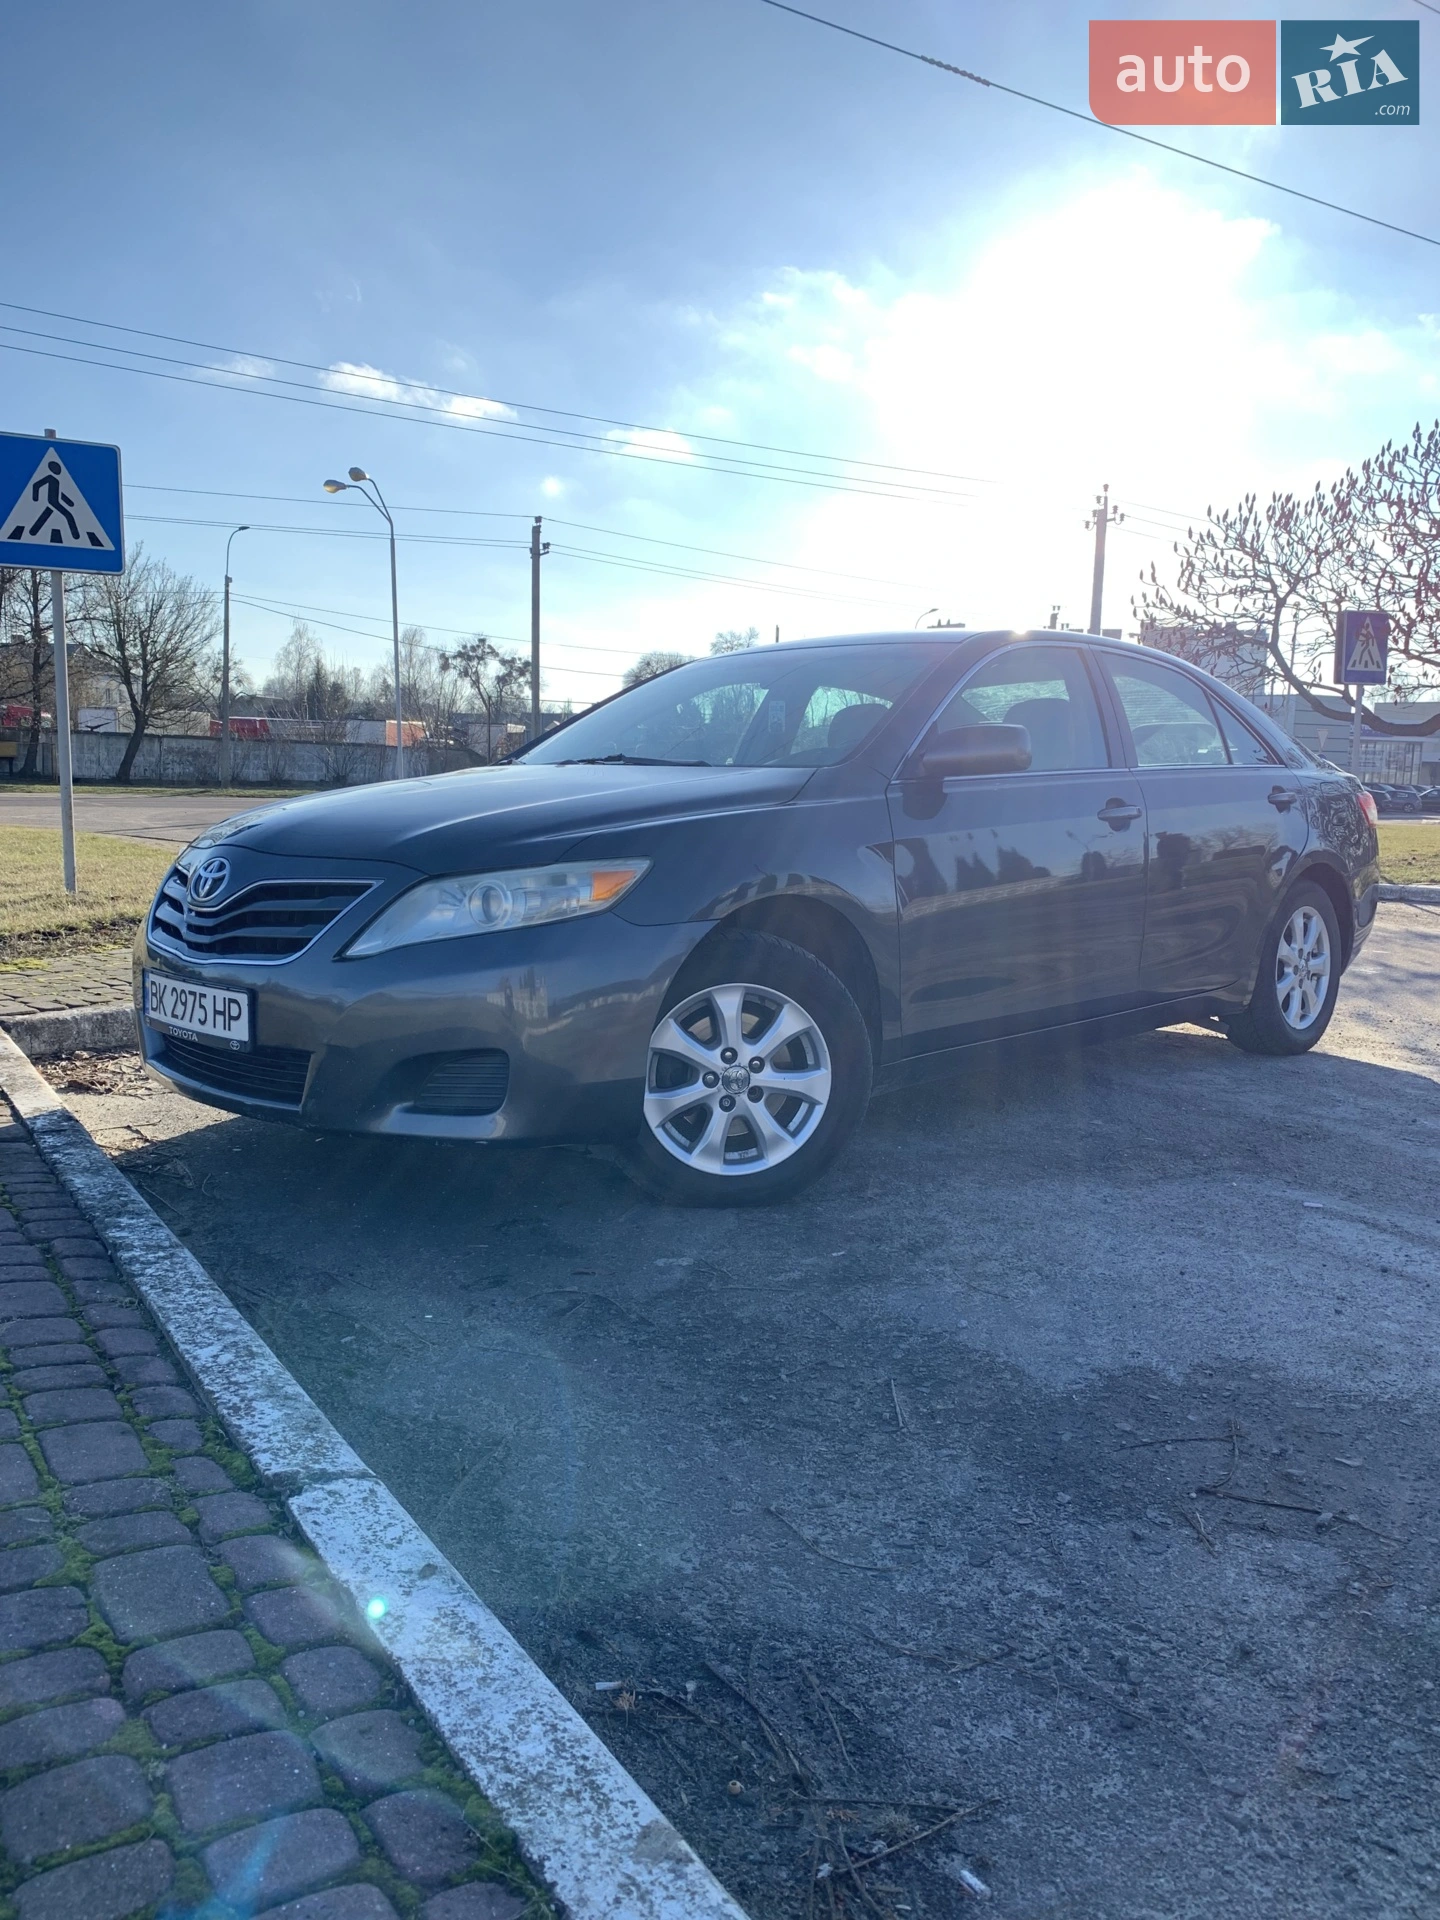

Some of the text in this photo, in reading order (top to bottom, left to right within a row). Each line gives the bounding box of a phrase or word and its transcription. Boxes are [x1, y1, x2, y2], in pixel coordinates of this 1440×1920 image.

[150, 981, 242, 1031] BK 2975 HP
[169, 1026, 198, 1041] TOYOTA
